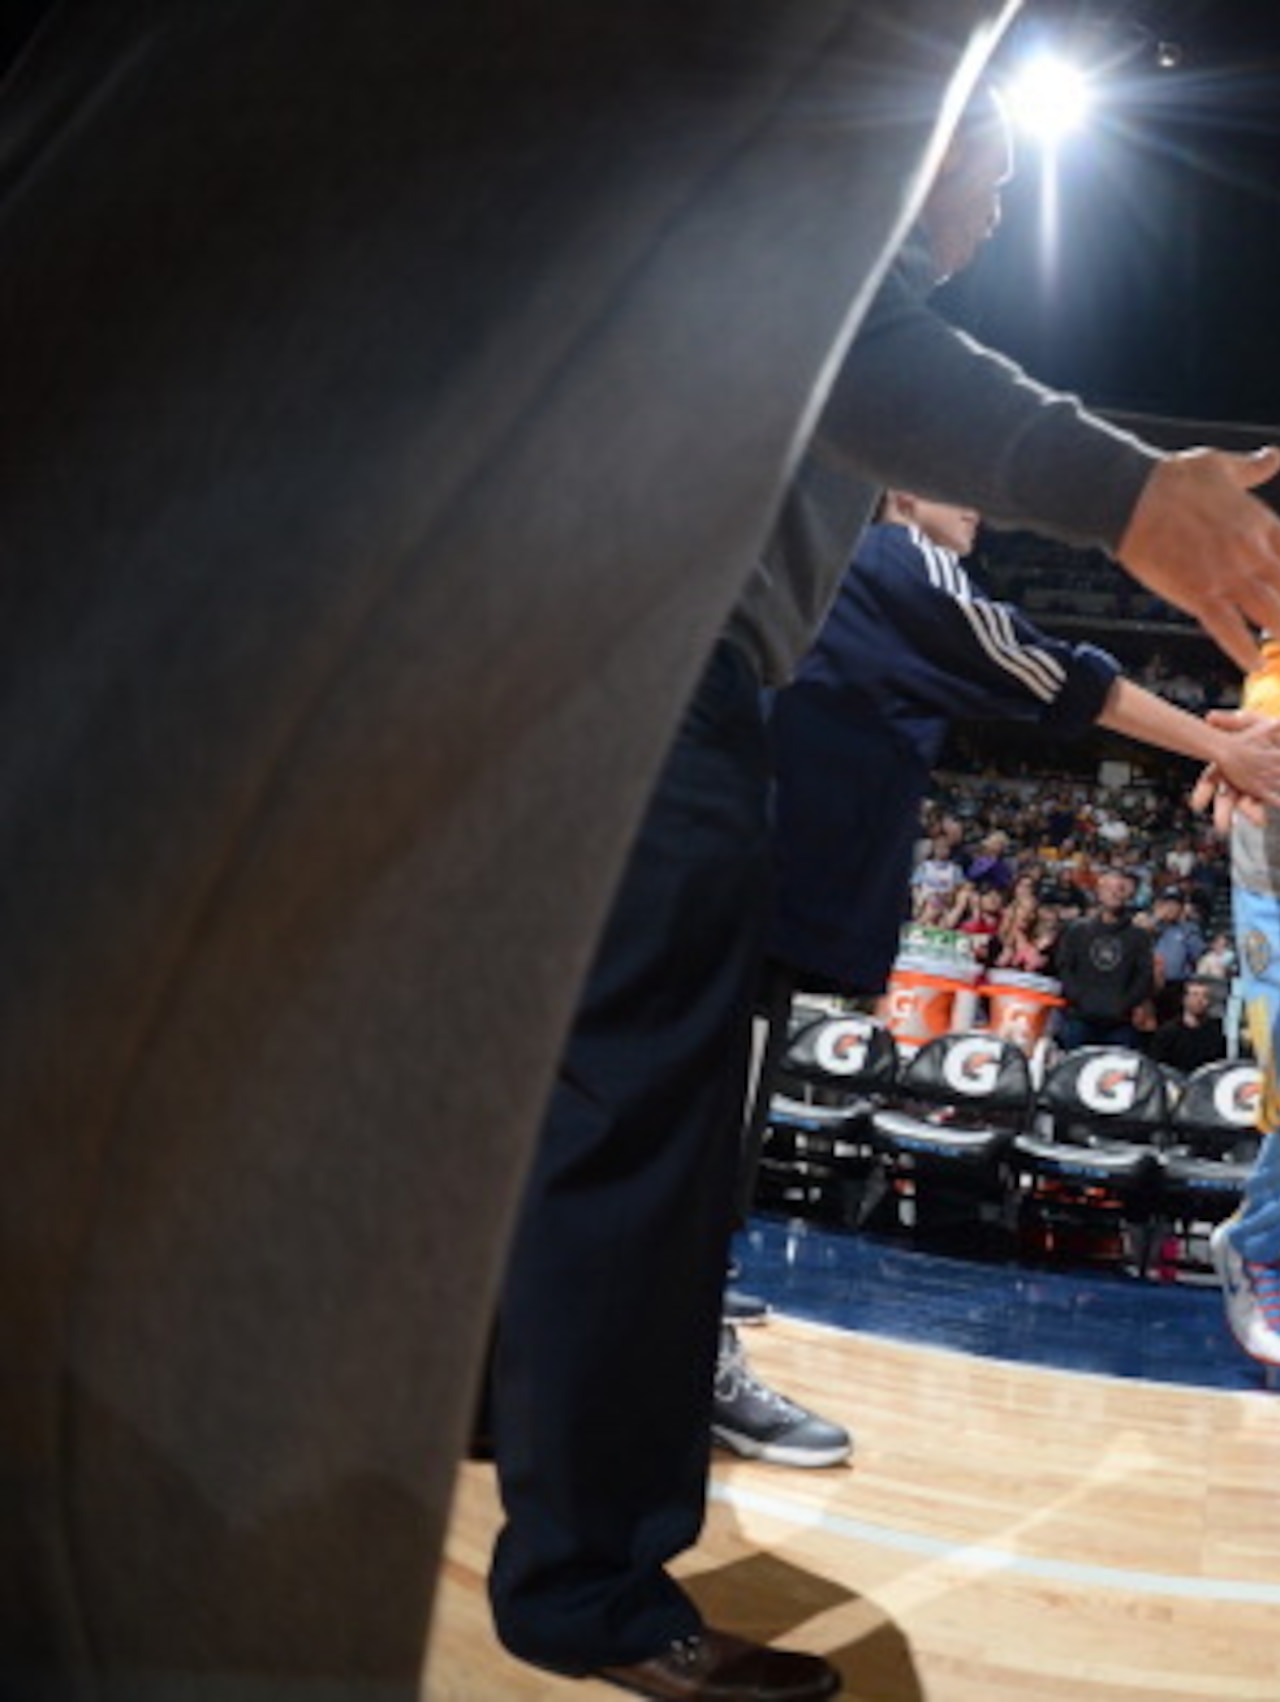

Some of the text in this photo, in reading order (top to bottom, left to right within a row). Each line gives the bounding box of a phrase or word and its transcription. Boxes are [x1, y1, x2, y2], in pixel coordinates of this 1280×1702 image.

[815, 1018, 872, 1074] G
[943, 1036, 1000, 1095] G
[1077, 1054, 1139, 1114] G
[1214, 1066, 1263, 1126] G
